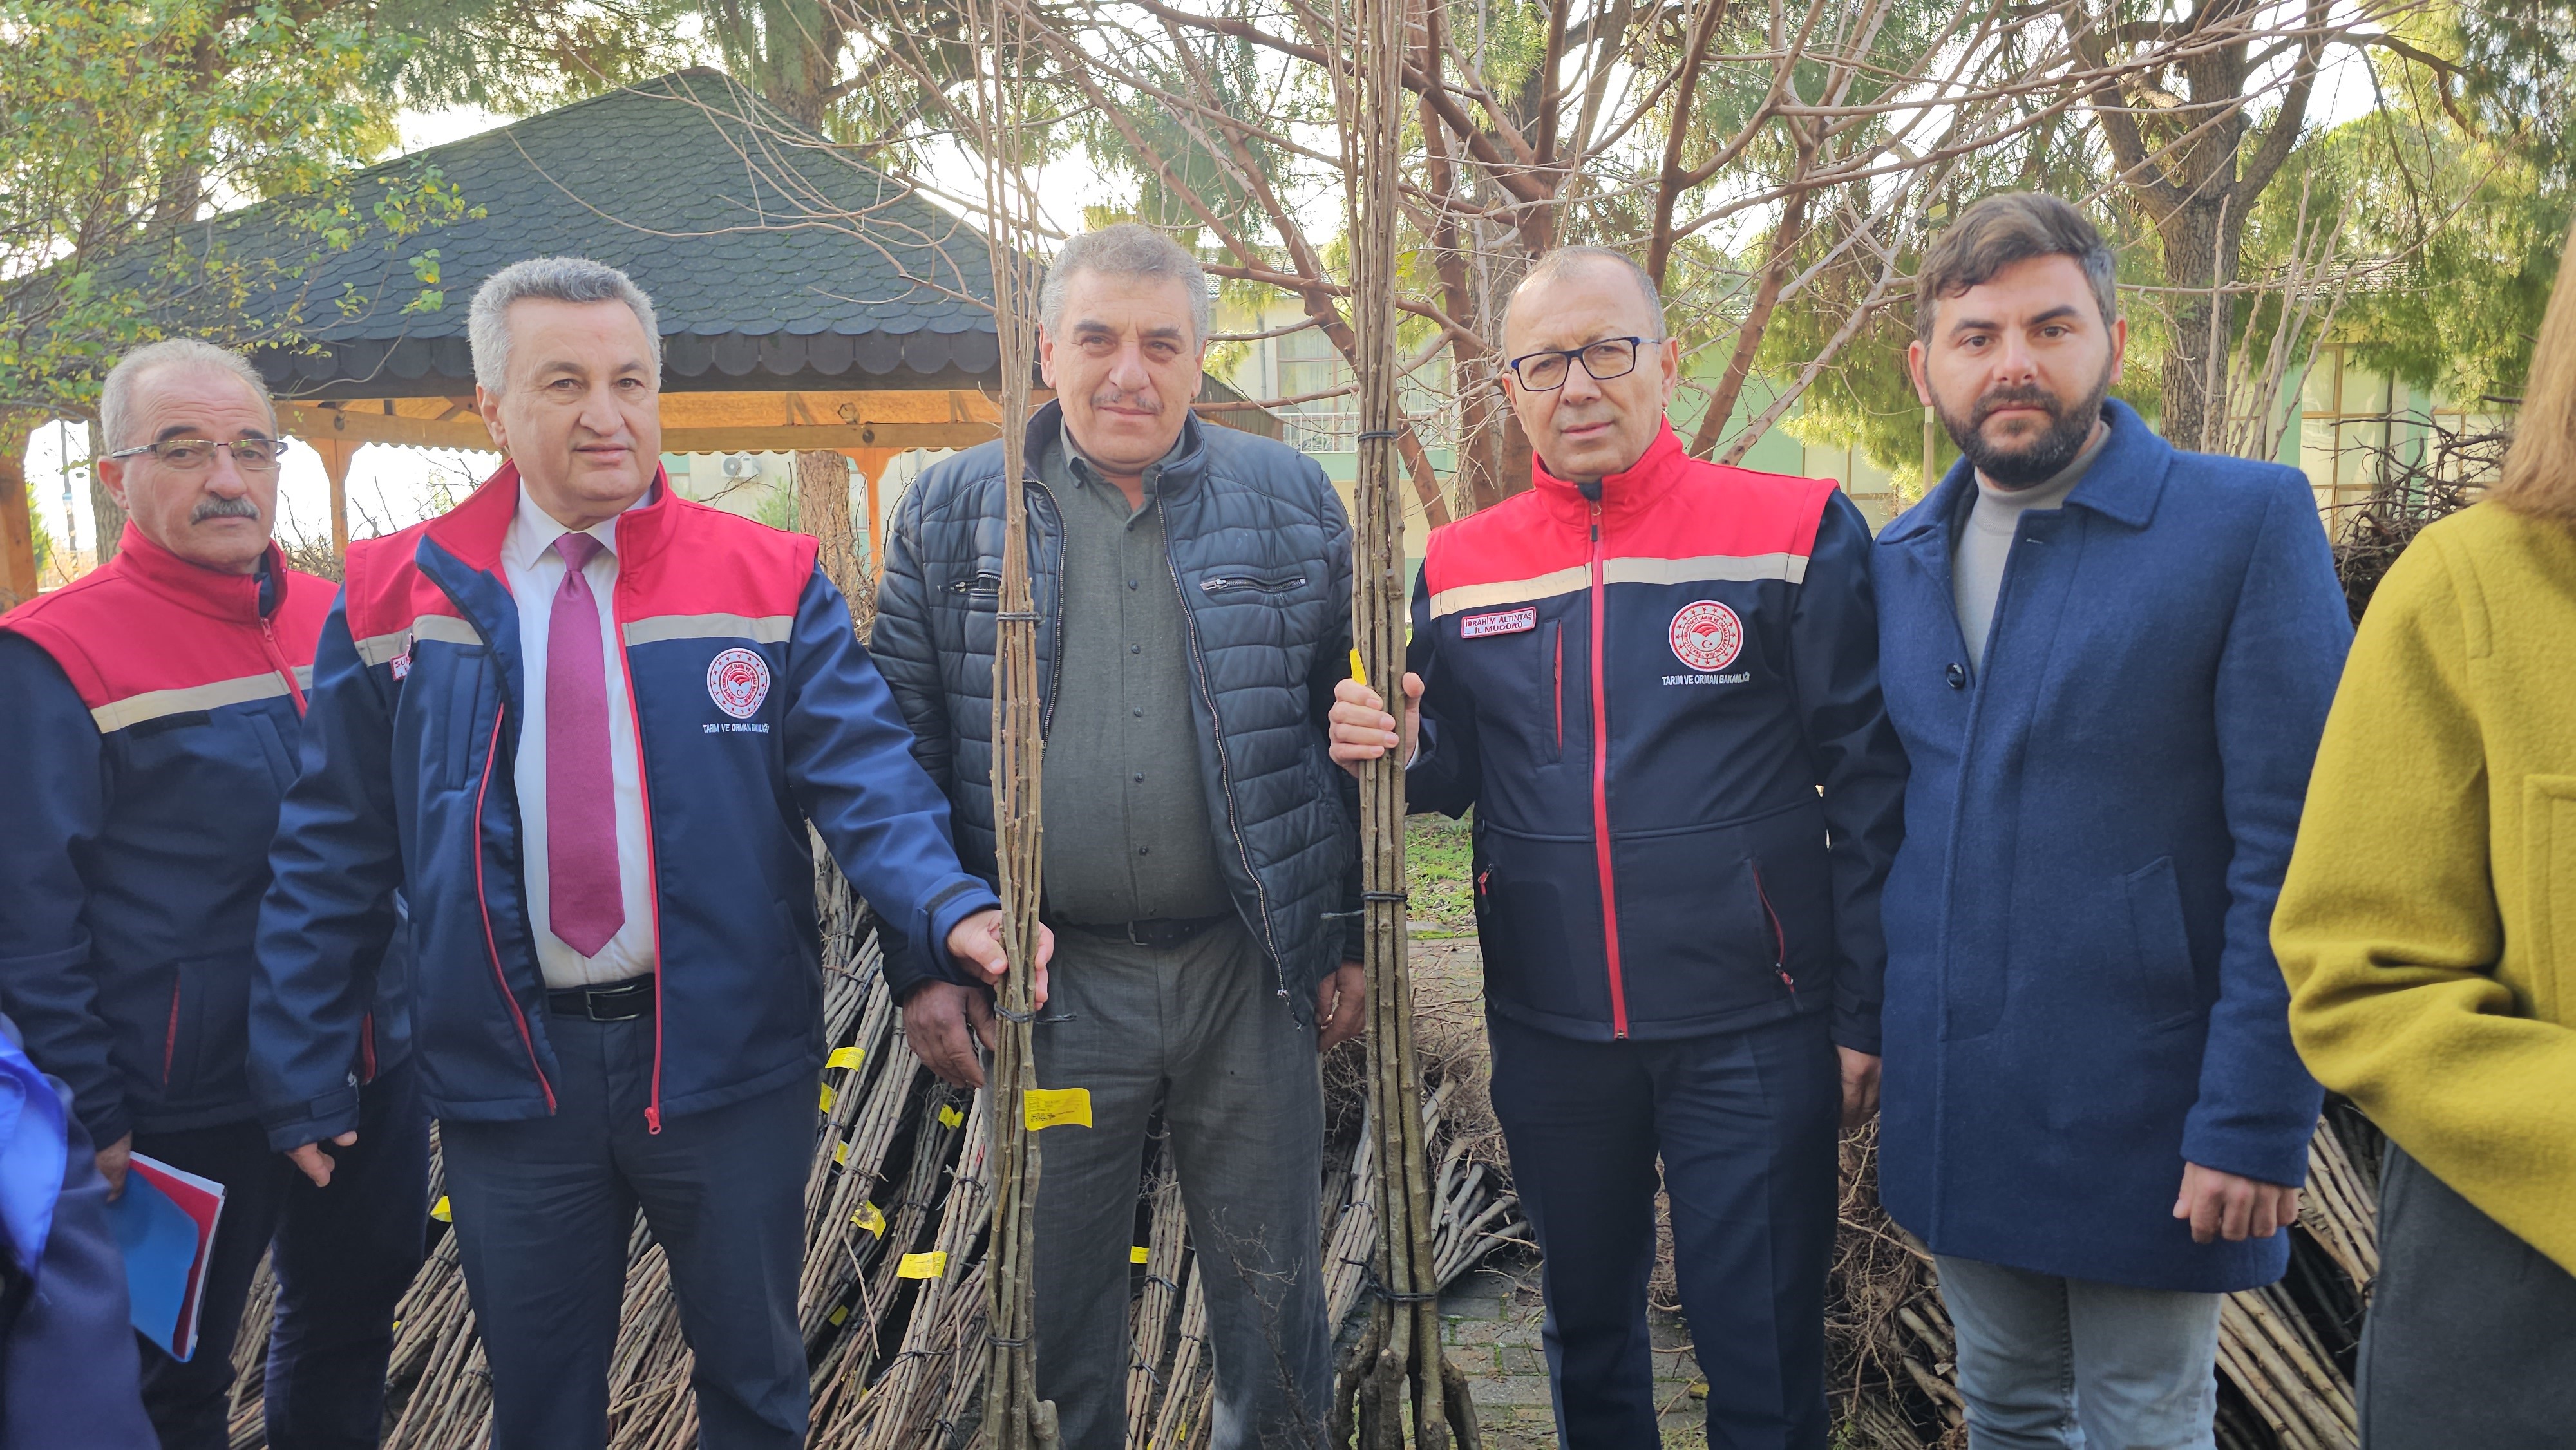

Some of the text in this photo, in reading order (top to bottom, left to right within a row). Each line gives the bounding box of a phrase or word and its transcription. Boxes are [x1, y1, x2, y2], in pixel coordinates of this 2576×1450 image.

[1499, 612, 1532, 624] ALTINTAŞ
[1485, 621, 1523, 632] MÜDÜRÜ
[1662, 675, 1683, 685] TARIM
[1684, 675, 1694, 685] VE
[1694, 674, 1718, 684] ORMAN
[703, 723, 719, 733] TARIM
[721, 723, 730, 732] VE
[732, 723, 751, 732] ORMAN
